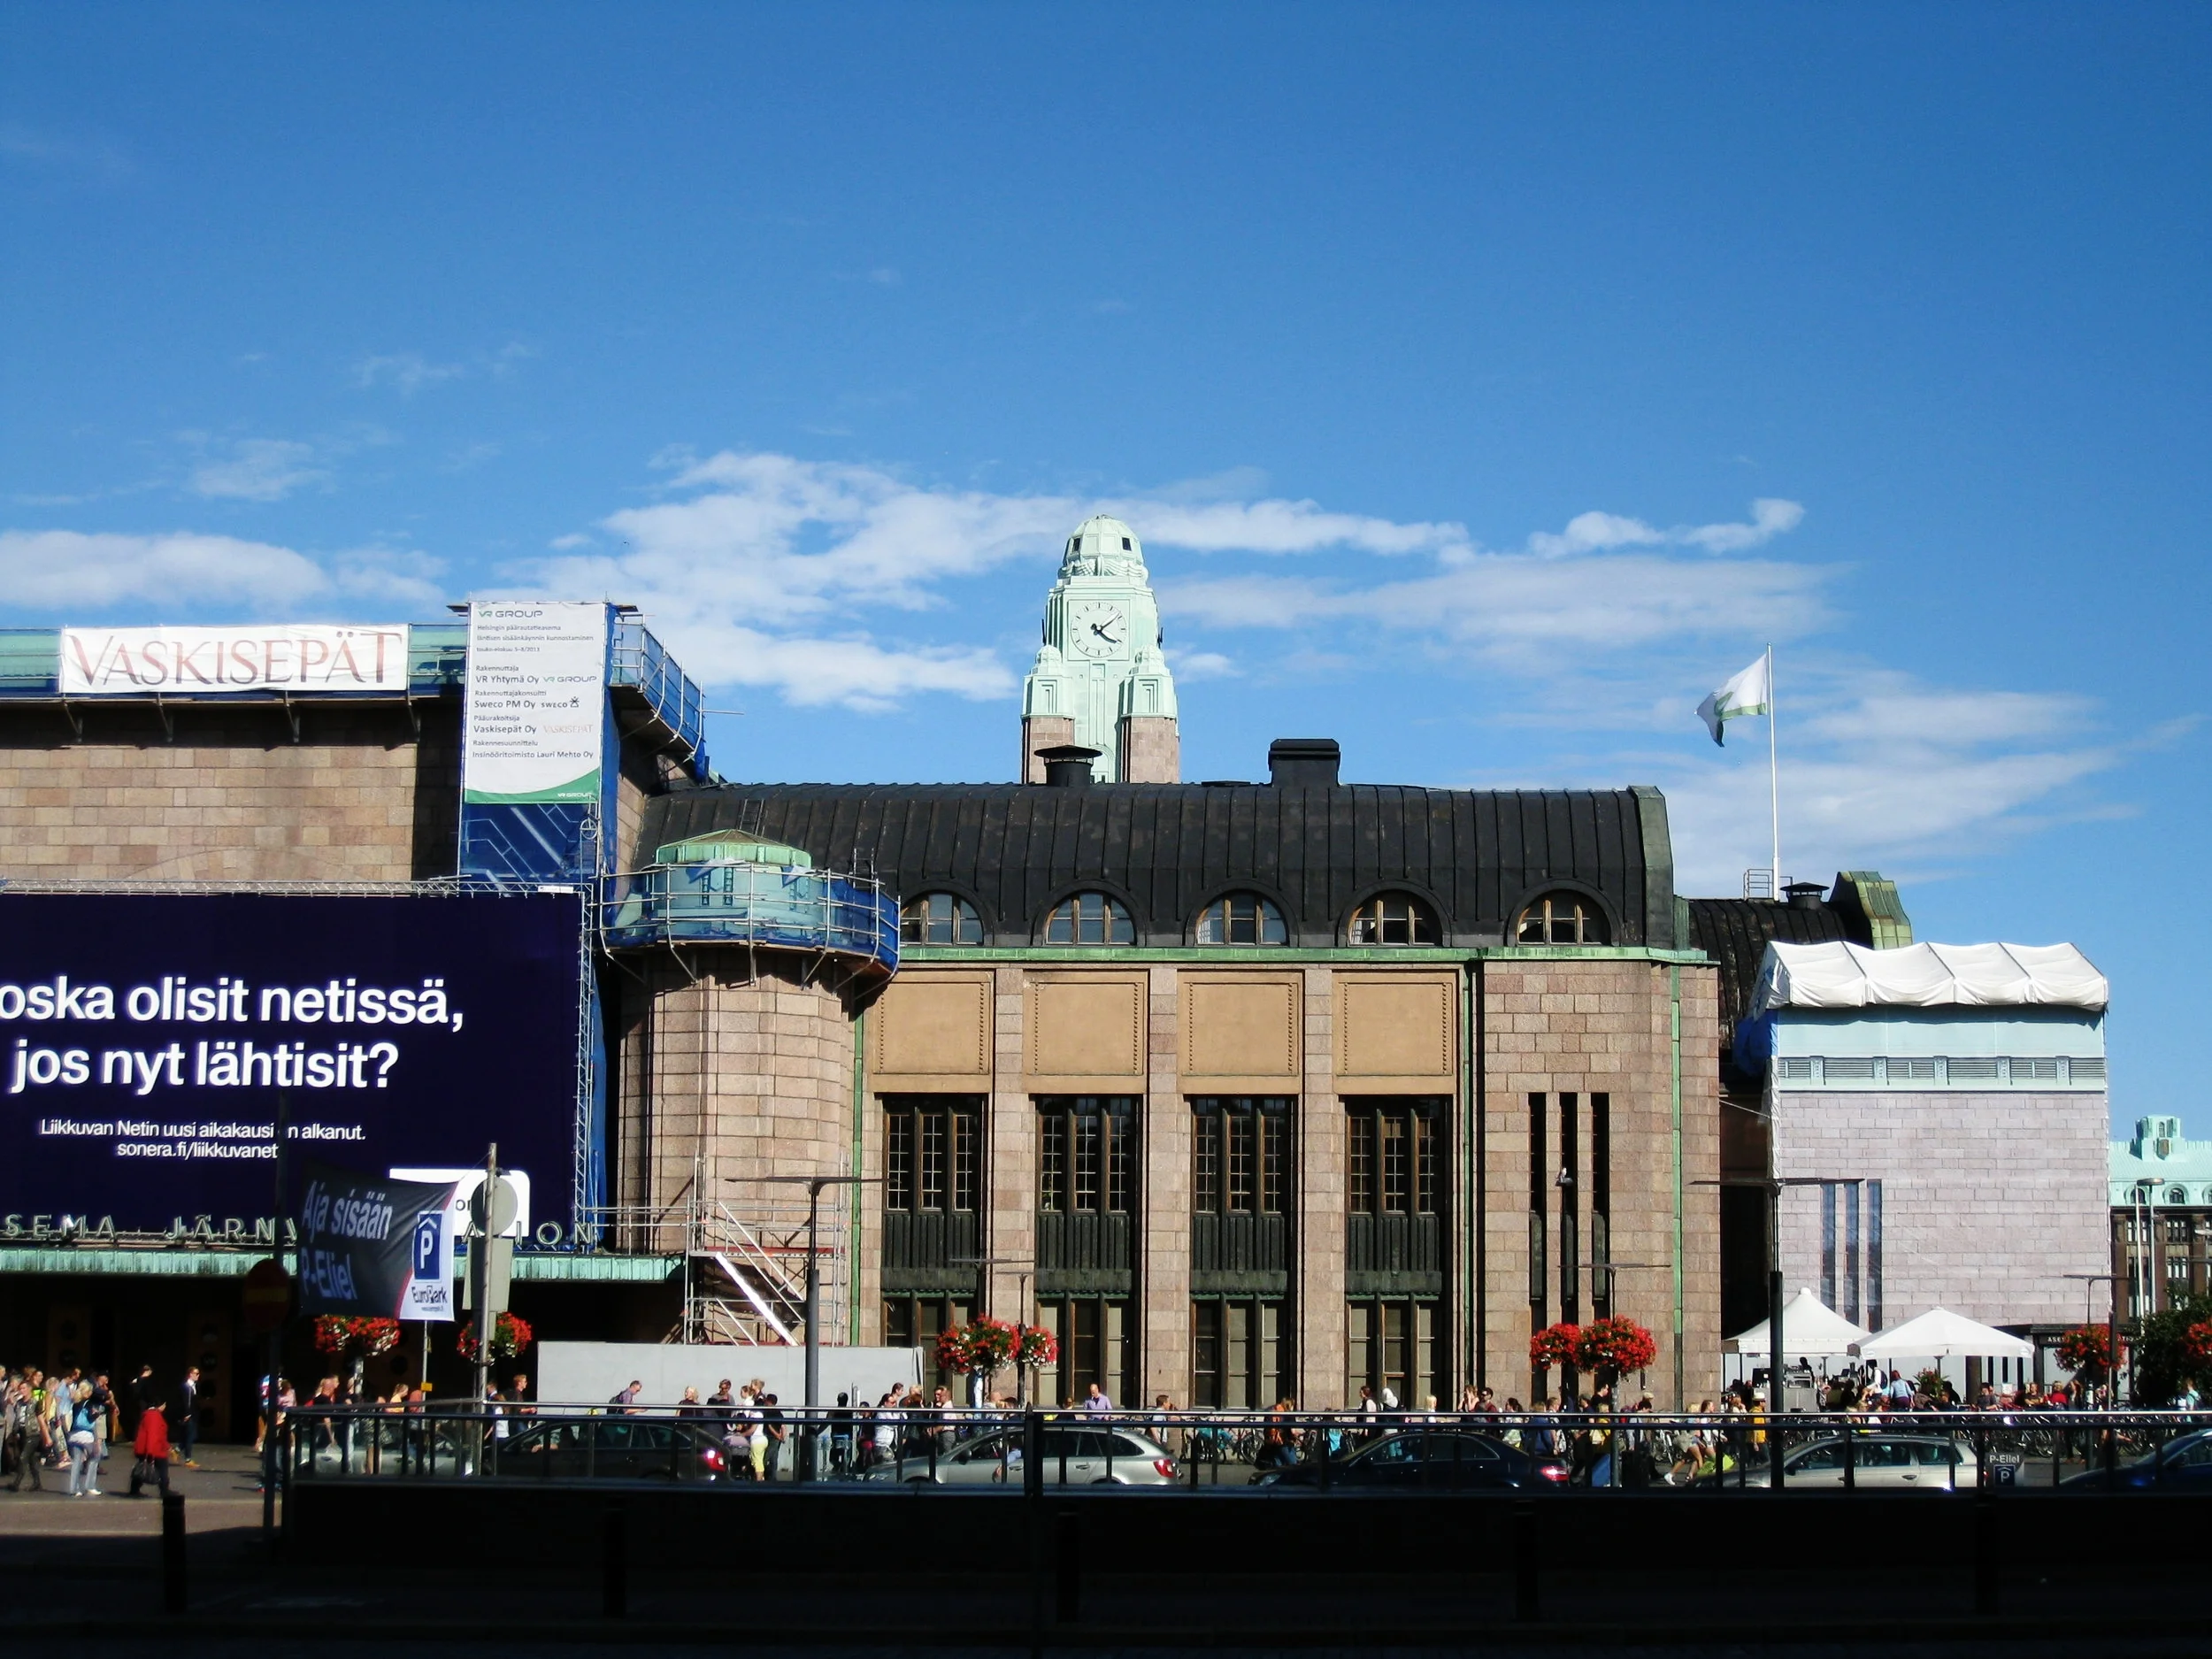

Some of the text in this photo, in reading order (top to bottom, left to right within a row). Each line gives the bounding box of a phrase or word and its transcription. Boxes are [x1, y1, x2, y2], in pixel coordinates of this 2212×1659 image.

[69, 630, 403, 685] VASKISEPÄT
[491, 675, 525, 685] Yhtymä
[526, 675, 540, 684] Oy
[524, 700, 535, 709] Oy
[128, 977, 249, 1021] olisit
[261, 979, 465, 1033] netissä,
[10, 1039, 399, 1095] jos nyt lähtisit?
[41, 1119, 113, 1136] Liikkuvan
[118, 1121, 159, 1136] Netin
[164, 1121, 196, 1137] uusi
[199, 1122, 274, 1139] aikakausi
[302, 1124, 366, 1141] alkanut.
[118, 1141, 279, 1160] sonera.fi/liikkuvanet
[302, 1179, 394, 1243] Aja sisään
[301, 1247, 358, 1301] P-Eliel
[1989, 1454, 2020, 1463] P-Eliel
